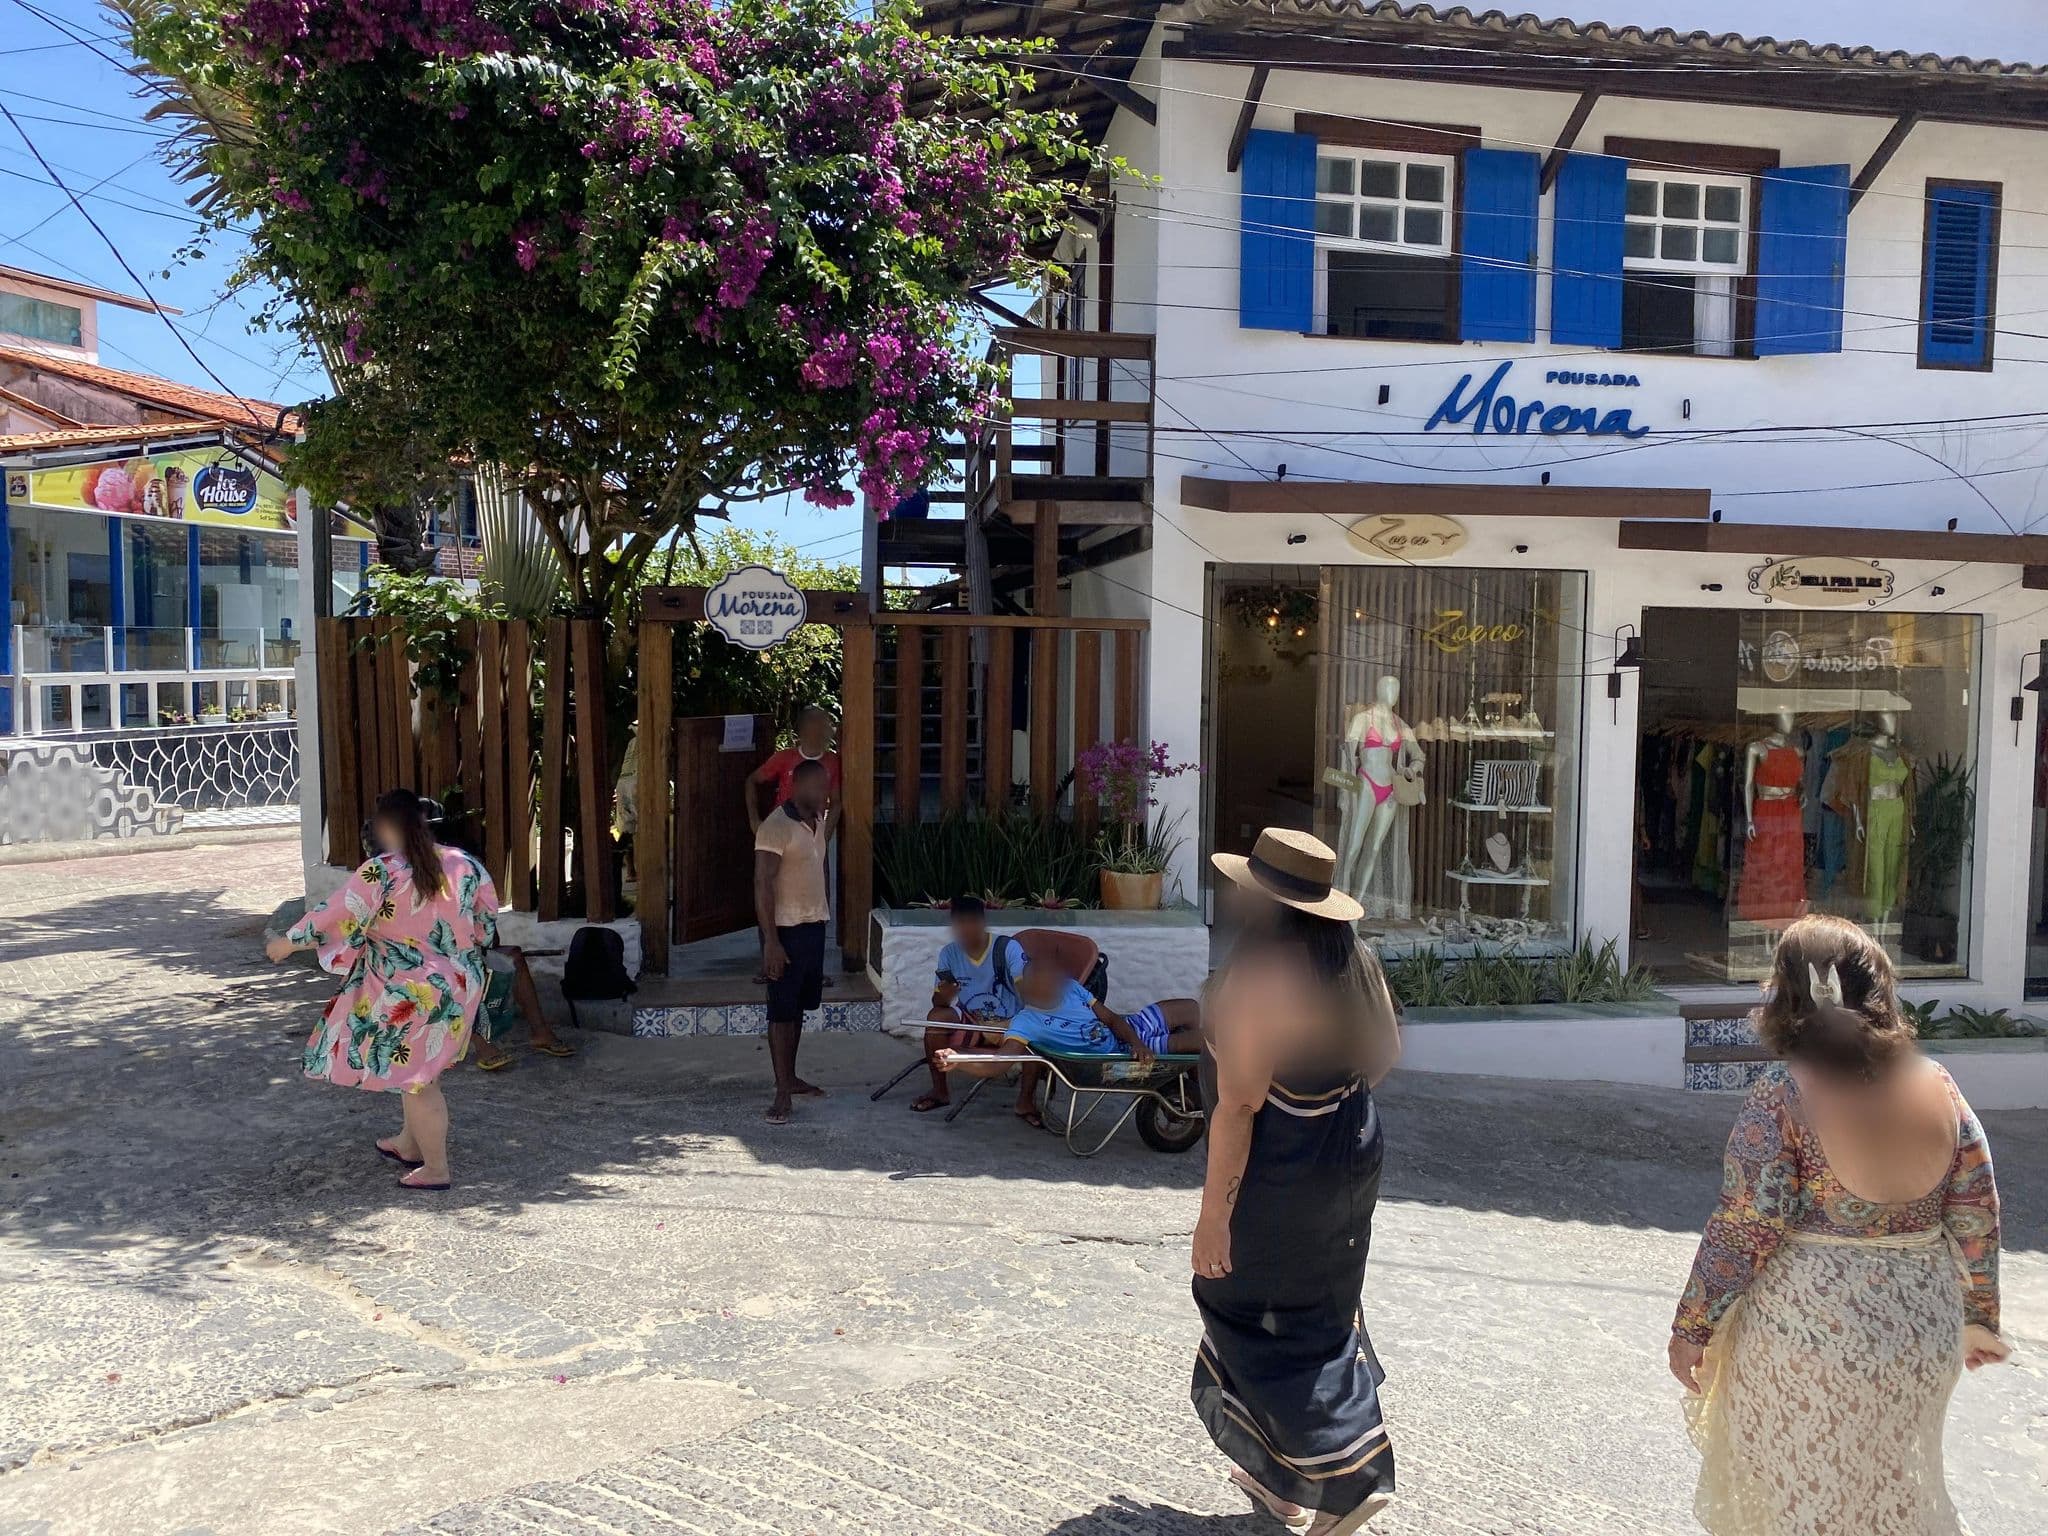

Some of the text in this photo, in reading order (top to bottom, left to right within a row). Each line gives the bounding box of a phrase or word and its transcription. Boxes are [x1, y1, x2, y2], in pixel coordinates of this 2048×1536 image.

[1545, 371, 1641, 388] POUSADA
[1423, 361, 1650, 439] Morena
[216, 469, 237, 491] Ice
[199, 485, 248, 503] House
[711, 593, 800, 617] Morena
[742, 591, 794, 600] POUSADA
